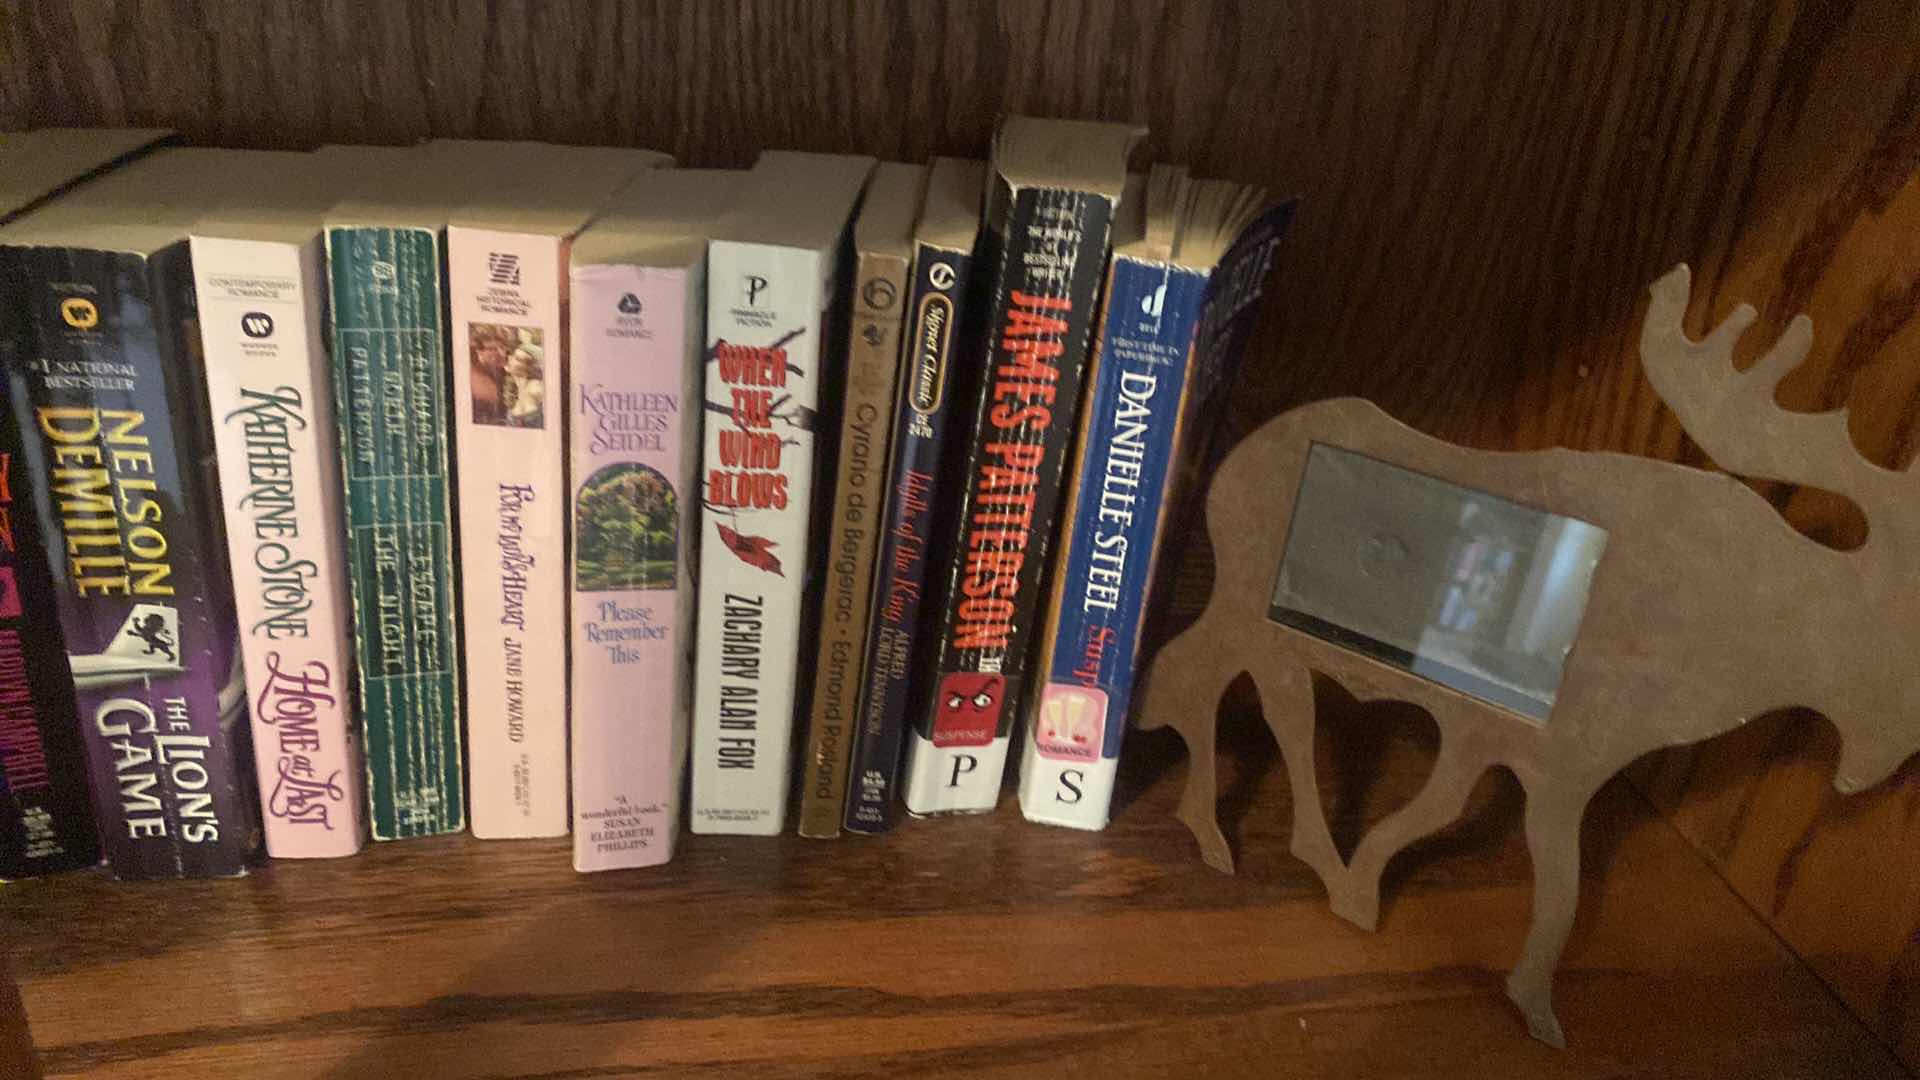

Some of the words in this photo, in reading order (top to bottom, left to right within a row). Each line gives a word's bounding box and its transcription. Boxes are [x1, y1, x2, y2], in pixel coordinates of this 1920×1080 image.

[56, 360, 138, 378] NATIONAL
[717, 345, 788, 388] WHEN
[991, 288, 1073, 431] JAMES
[43, 375, 136, 392] BESTSELLER
[731, 386, 774, 429] THE
[225, 386, 307, 537] KATHERINE
[718, 429, 783, 470] WIND
[850, 402, 880, 487] Cyrano
[1099, 369, 1157, 527] DANIELLE
[36, 405, 132, 600] DEMILLE
[100, 408, 175, 597] NELSON
[708, 468, 789, 512] BLOWS
[846, 492, 867, 522] de
[375, 534, 399, 572] THE
[953, 441, 1046, 651] PATTERSON
[252, 541, 318, 640] STONE
[835, 528, 866, 623] Bergerac
[1084, 529, 1129, 613] STEEL
[597, 600, 653, 623] Please
[880, 576, 920, 624] King
[380, 593, 403, 663] NIGHT
[583, 620, 669, 643] Remember
[720, 592, 765, 680] ZACHARY
[504, 637, 524, 679] JANE
[604, 646, 641, 666] This
[257, 651, 337, 755] HOME
[824, 641, 851, 721] Edmond
[163, 695, 191, 732] THE
[505, 680, 525, 744] HOWARD
[719, 685, 760, 731] ALAN
[717, 736, 756, 770] FOX
[933, 728, 988, 742] SUSPENSE
[1036, 742, 1092, 758] ROMANCE
[96, 697, 167, 840] GAME
[815, 725, 842, 800] Rostand
[943, 754, 978, 788] P
[152, 733, 220, 844] LION'S
[269, 757, 345, 832] LAST
[1055, 768, 1085, 805] S
[590, 827, 655, 843] ELIZABETH
[596, 838, 649, 853] PHILLIPS
[603, 817, 642, 830] SUSAN
